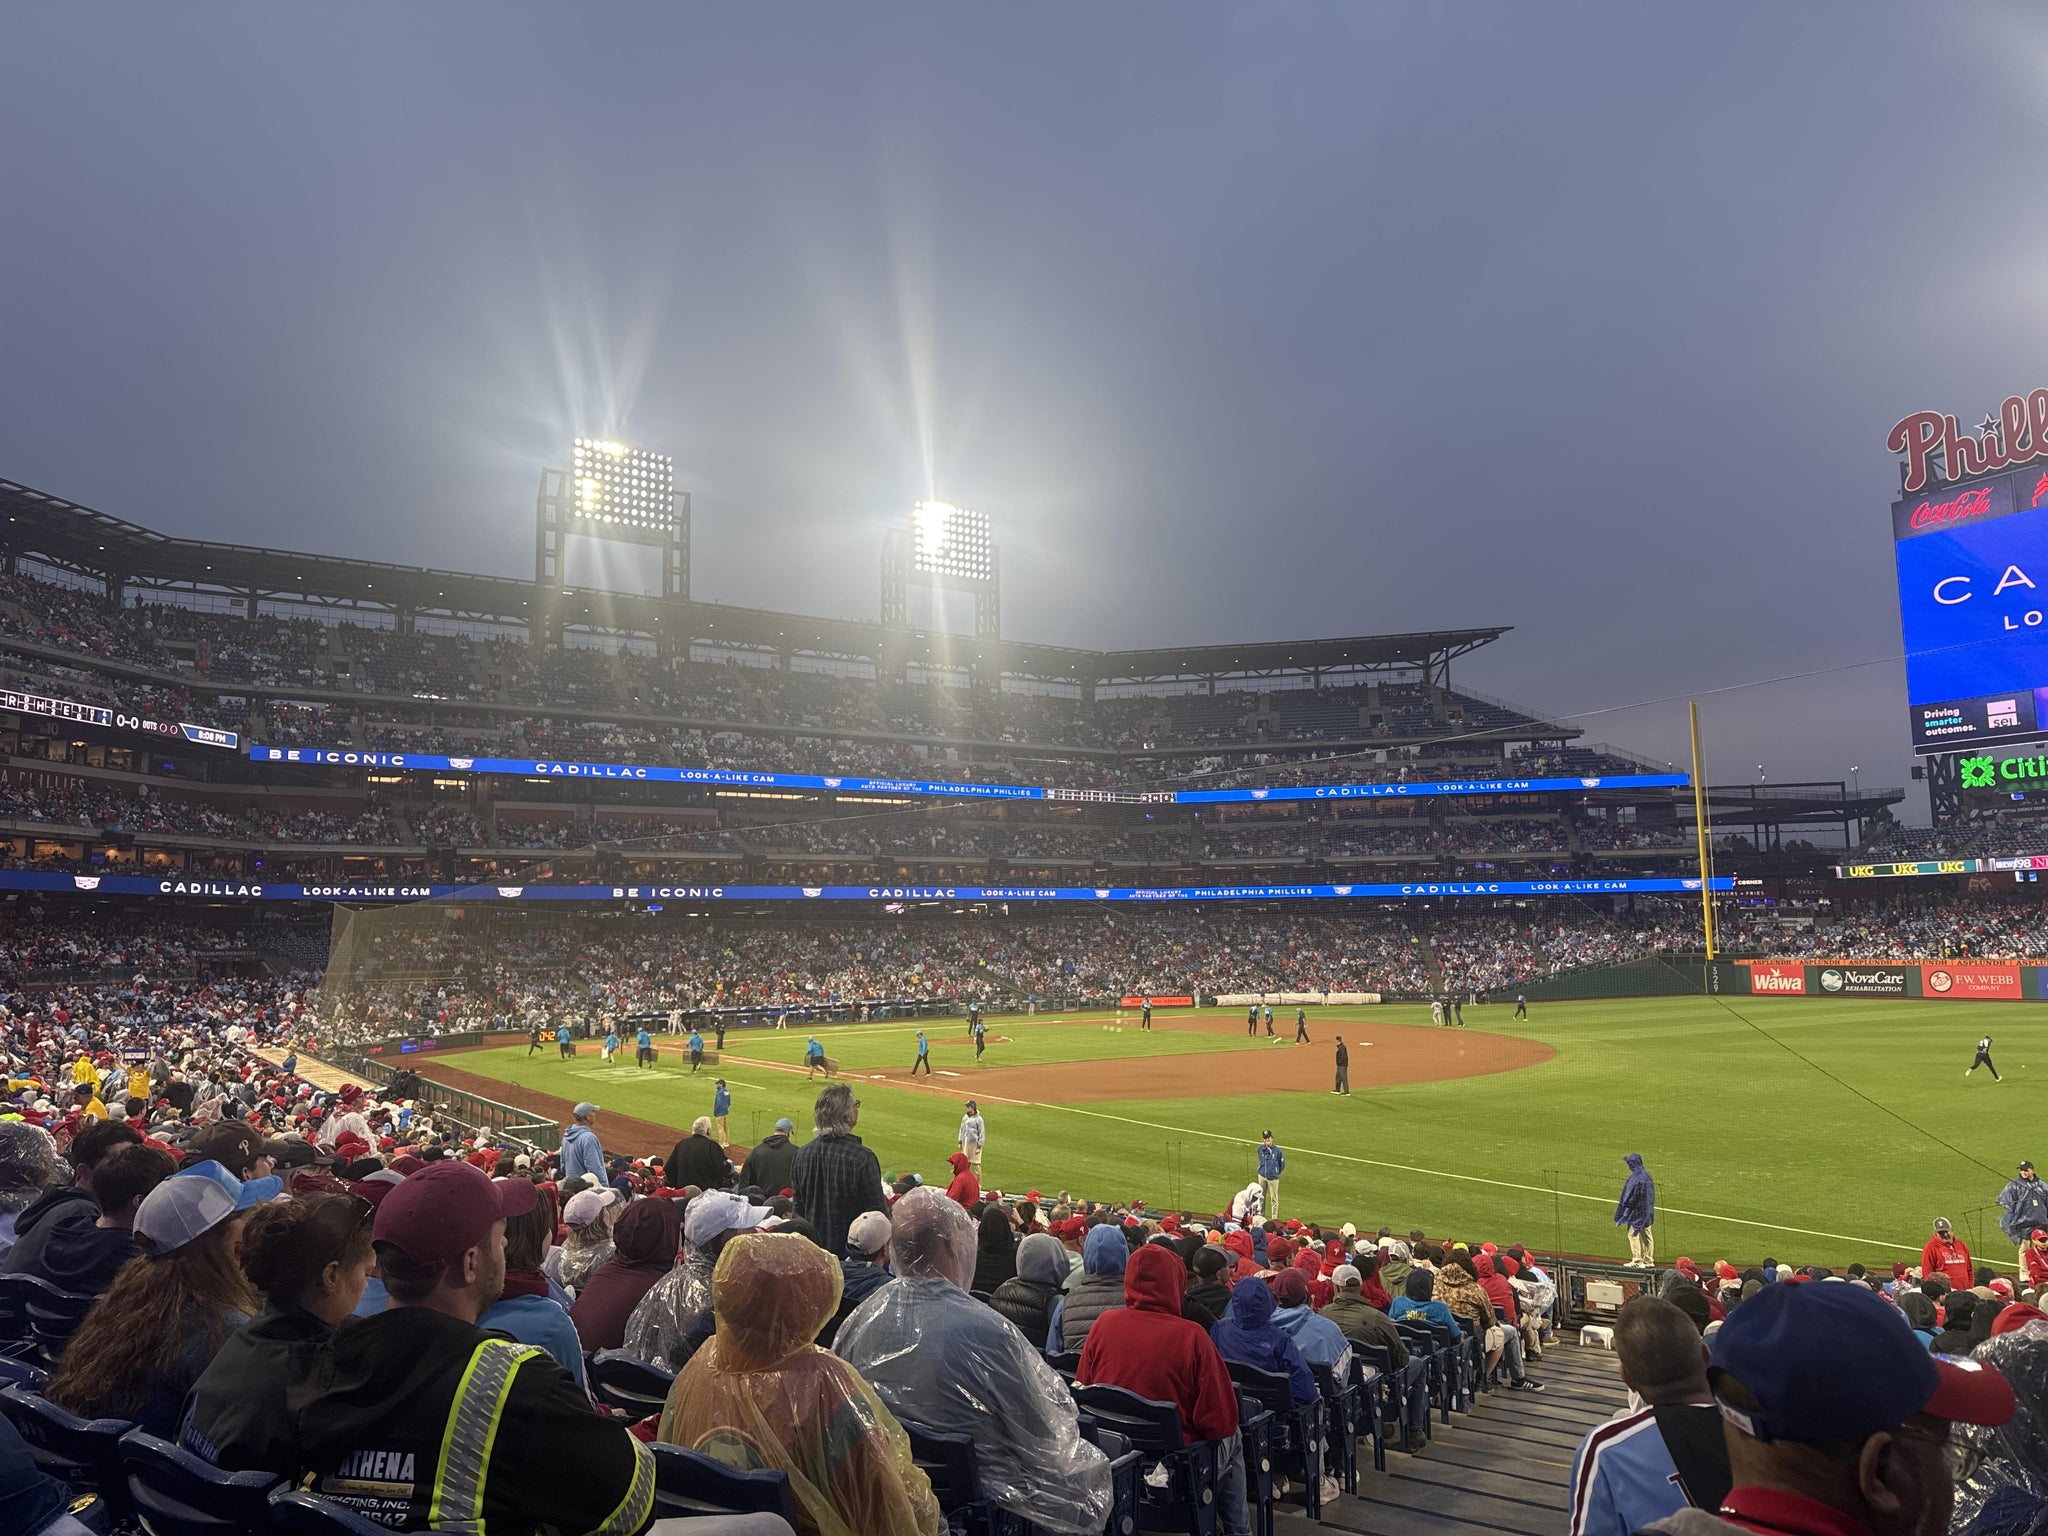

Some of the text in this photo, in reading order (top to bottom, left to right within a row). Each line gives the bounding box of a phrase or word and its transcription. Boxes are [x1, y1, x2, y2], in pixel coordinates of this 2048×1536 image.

[1934, 565, 2036, 605] CA
[2004, 610, 2043, 631] LO
[9, 696, 70, 715] R H E
[1924, 708, 1960, 719] Driving
[143, 720, 157, 731] OUTS
[1925, 717, 1963, 727] smarter
[1926, 725, 1977, 736] outcomes.
[215, 732, 226, 743] PM
[269, 750, 404, 766] BE ICONIC
[535, 763, 647, 778] CADILLAC
[680, 771, 775, 783] LOOK-A-LIKE CAM
[928, 784, 1030, 796] PHILADELPHIA PHILLIES
[1316, 786, 1407, 796] CADILLAC
[1437, 783, 1502, 791] LOOK-A-LIKE
[1850, 866, 1874, 877] UKG
[1892, 864, 1918, 874] UKG
[1938, 861, 1965, 873] UKG
[160, 881, 262, 896] CADILLAC
[303, 887, 430, 896] LOOK-A-LIKE CAM
[1402, 884, 1499, 894] CADILLAC
[1531, 882, 1600, 891] LOOK-A-LIKE
[613, 888, 723, 897] BE ICONIC
[869, 889, 956, 898] CADILLAC
[1754, 974, 1803, 990] Wawa
[1843, 971, 1904, 984] NovaCare
[1955, 974, 2014, 984] F.W. WEBB
[239, 1140, 249, 1156] P
[340, 1450, 415, 1481] ATHENA
[382, 1500, 410, 1510] INC.
